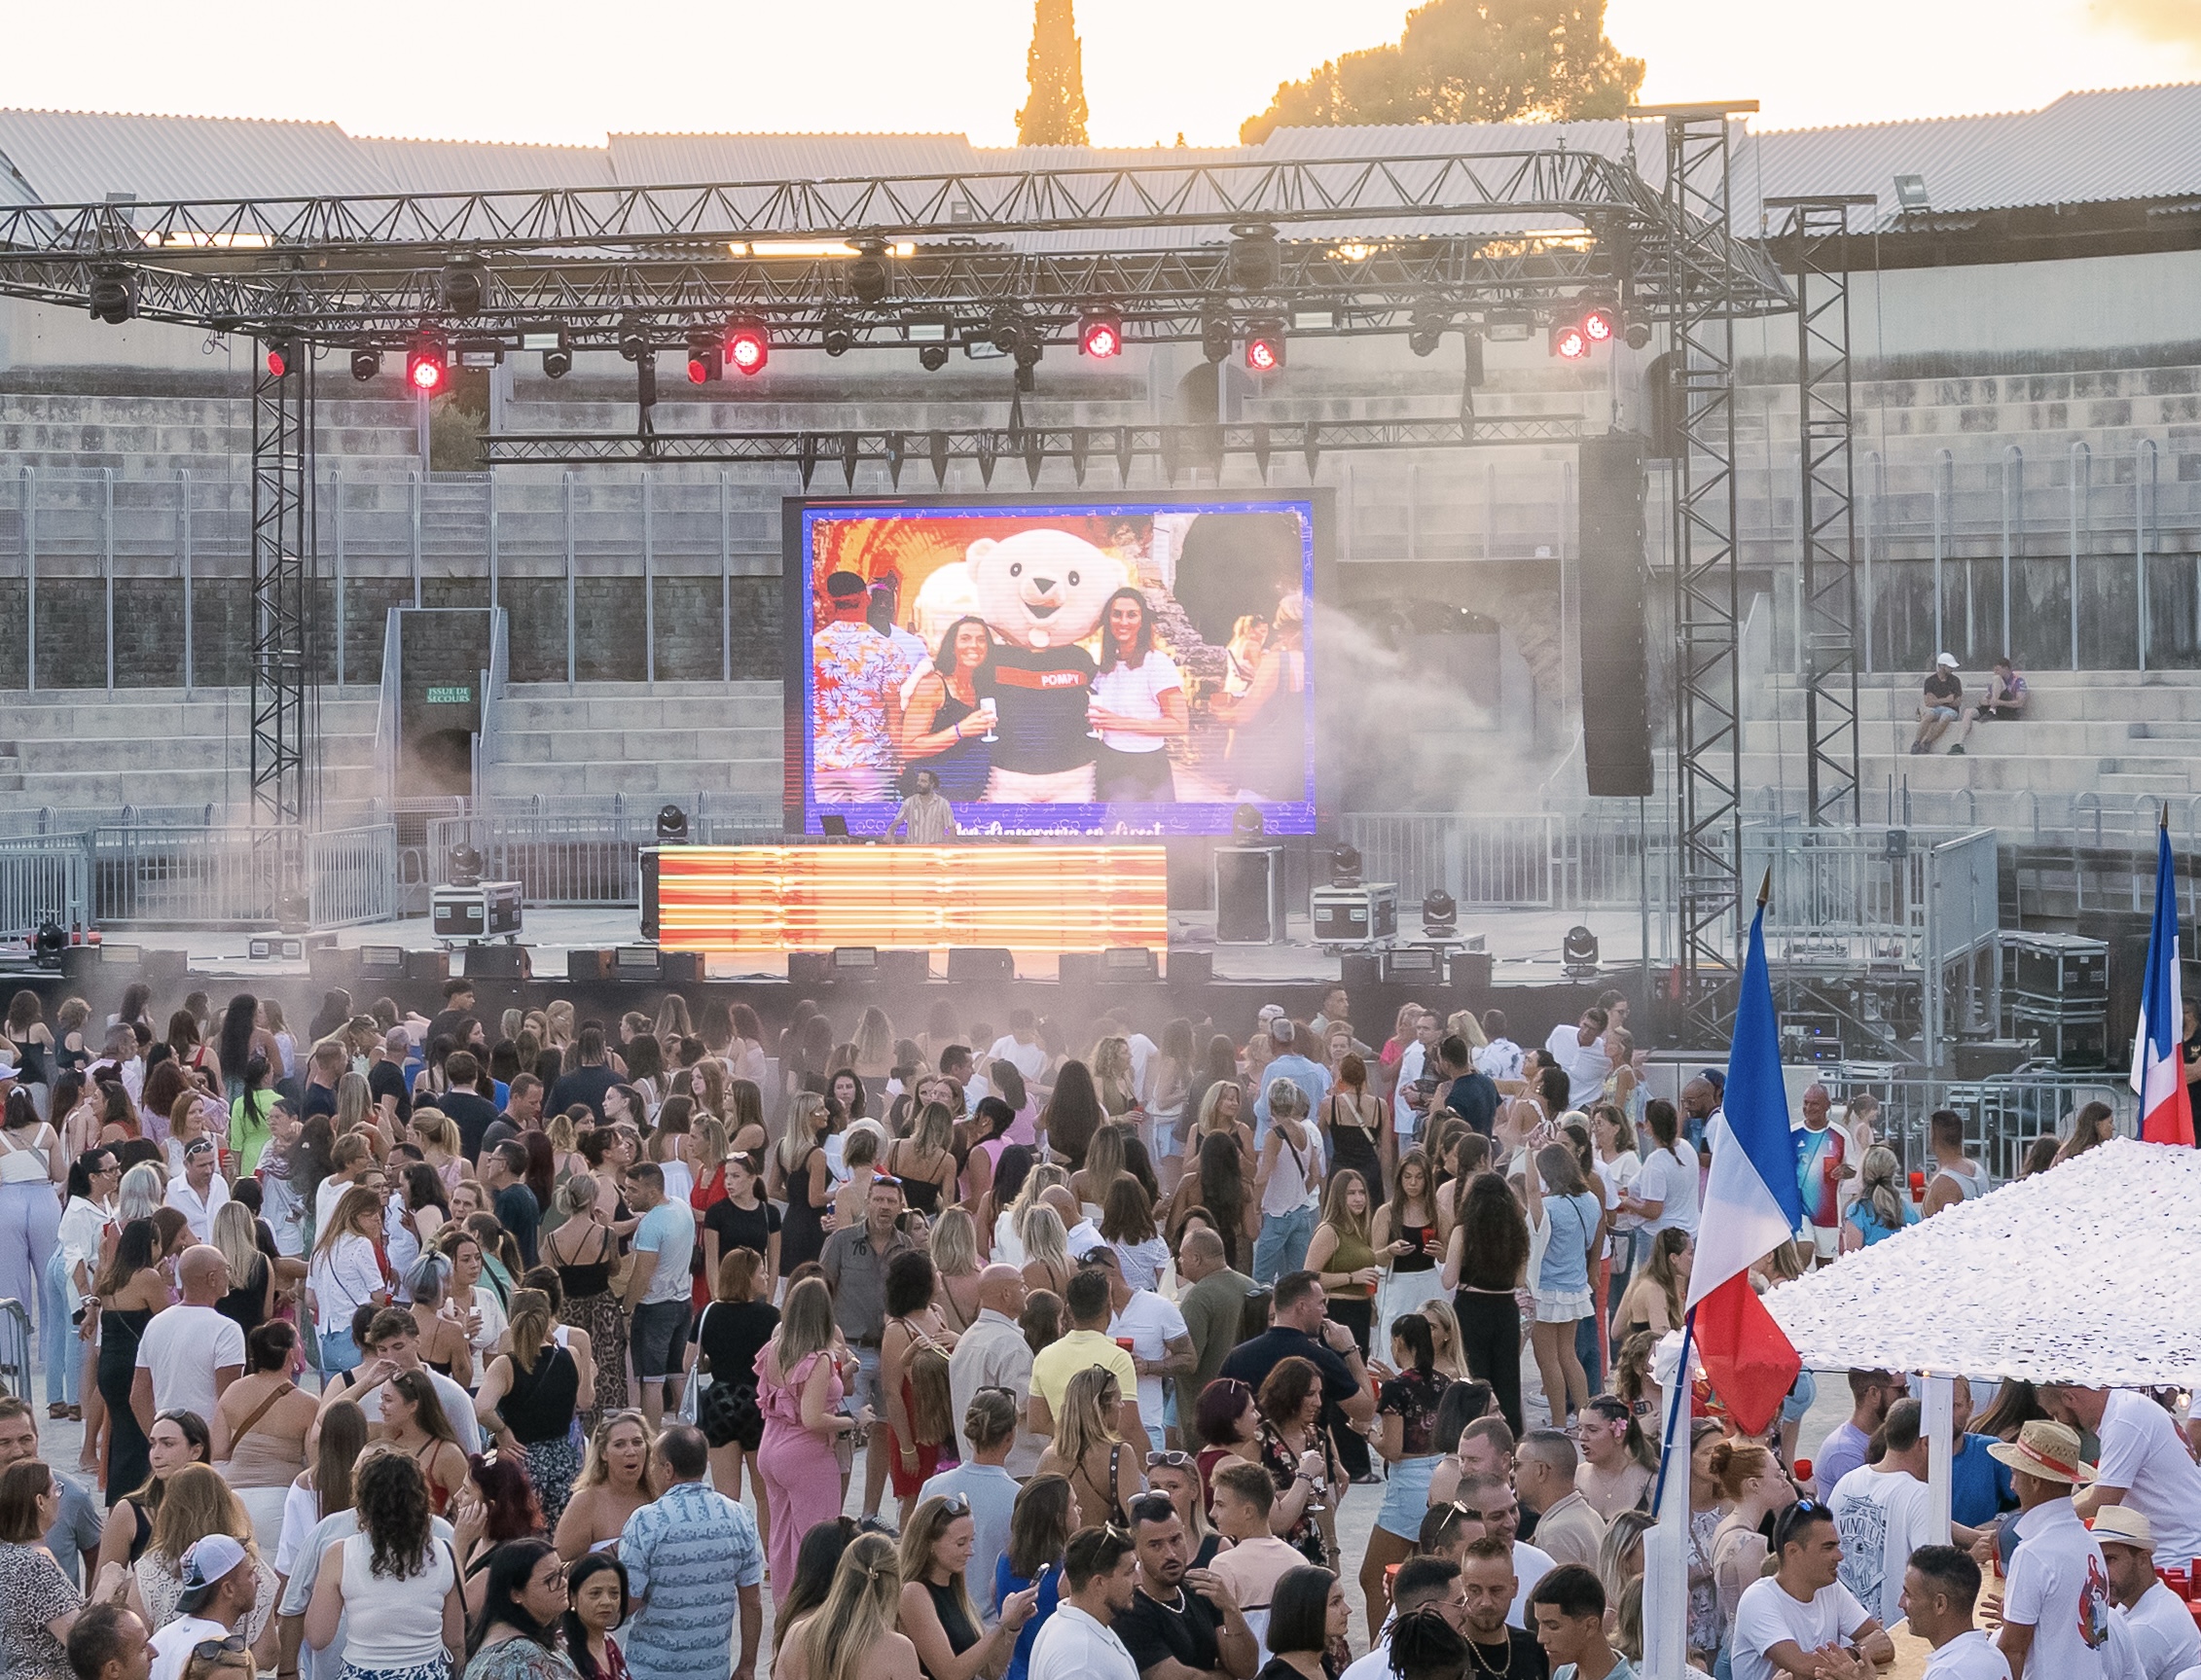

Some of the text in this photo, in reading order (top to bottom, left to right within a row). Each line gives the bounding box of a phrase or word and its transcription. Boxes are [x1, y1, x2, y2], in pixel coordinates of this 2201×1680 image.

[1041, 673, 1079, 687] POMPY
[428, 687, 452, 696] ISSUE
[852, 1237, 867, 1256] 76
